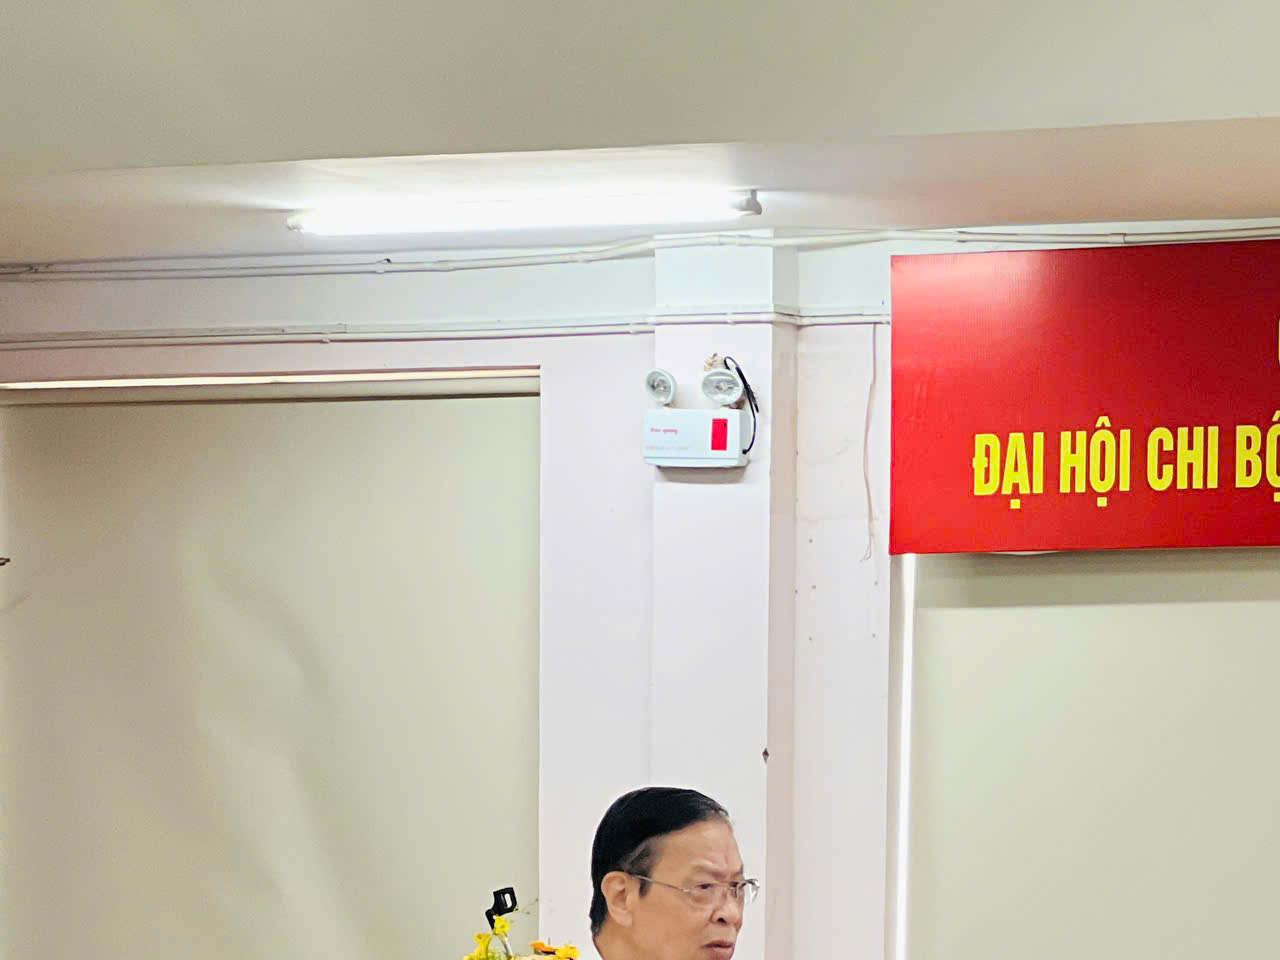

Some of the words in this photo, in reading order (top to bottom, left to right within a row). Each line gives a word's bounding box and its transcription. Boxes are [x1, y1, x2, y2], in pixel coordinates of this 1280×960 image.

[972, 431, 1046, 510] ĐẠI
[1058, 414, 1132, 508] HỘI
[1146, 426, 1220, 491] CHI
